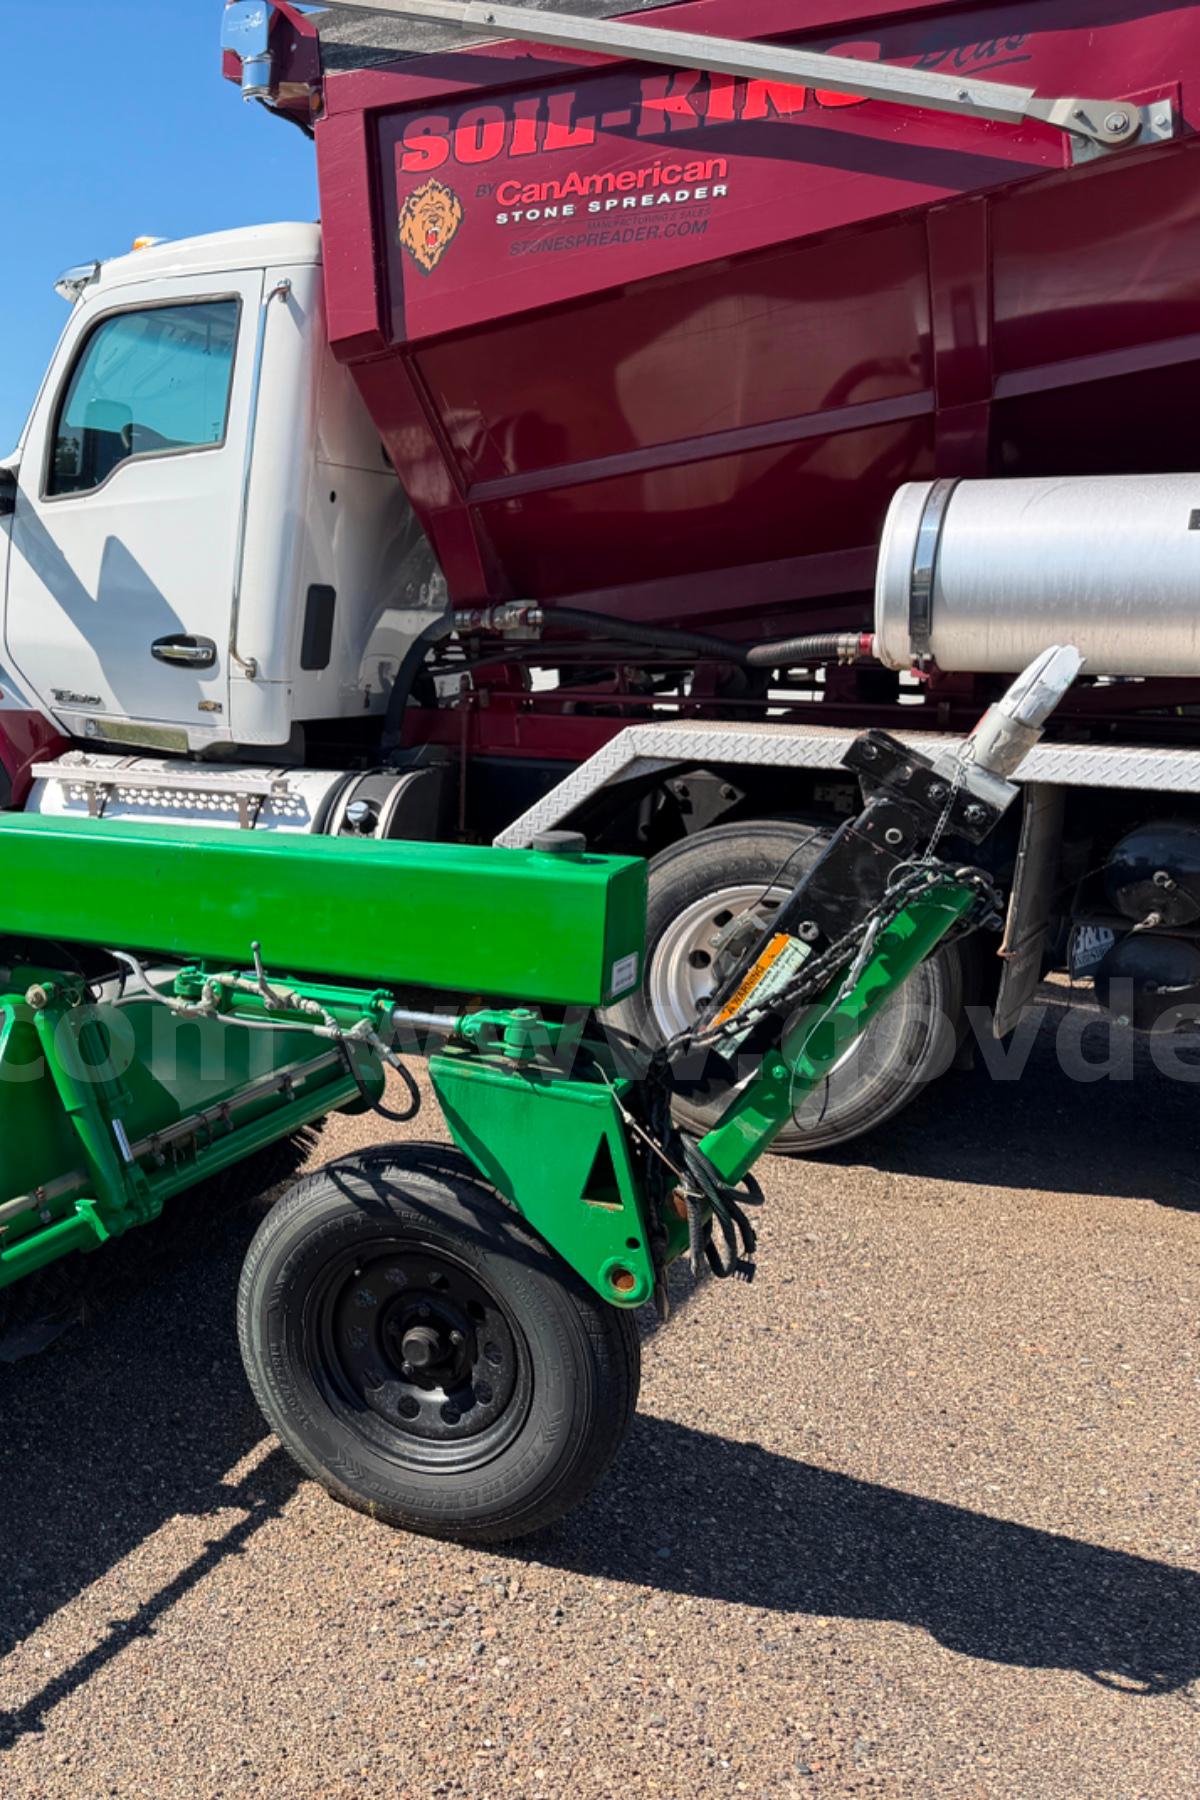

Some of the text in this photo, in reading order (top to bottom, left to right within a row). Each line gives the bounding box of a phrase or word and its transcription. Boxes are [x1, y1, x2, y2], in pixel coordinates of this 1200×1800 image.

[476, 157, 728, 207] BY CanAmerican
[496, 184, 729, 225] STONE SPREADER
[510, 220, 709, 257] STONESPREADER.COM
[734, 964, 765, 1005] WARNING
